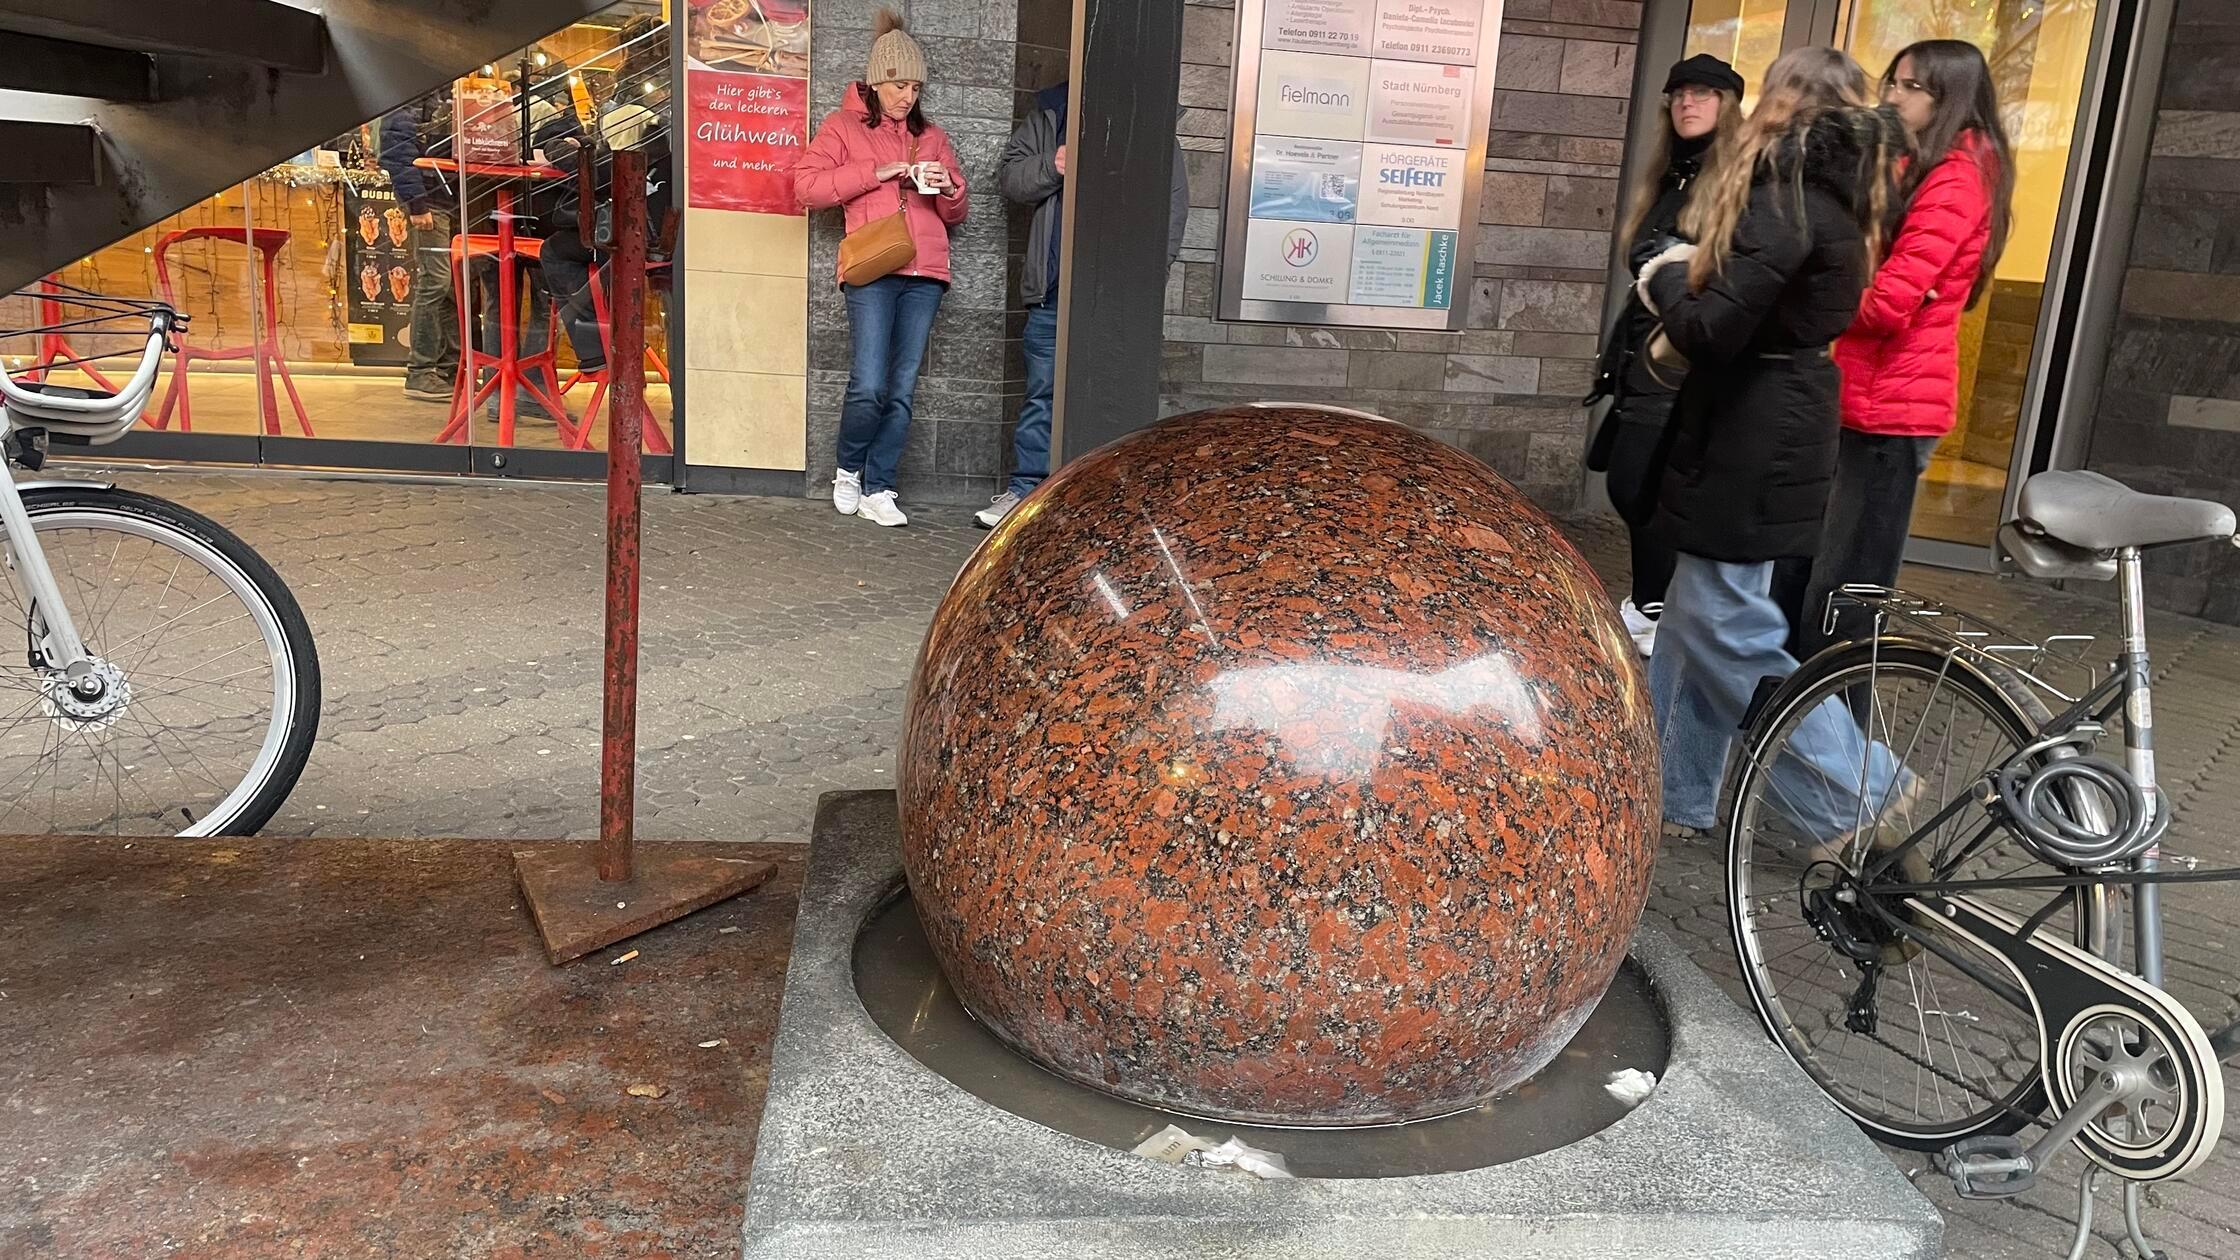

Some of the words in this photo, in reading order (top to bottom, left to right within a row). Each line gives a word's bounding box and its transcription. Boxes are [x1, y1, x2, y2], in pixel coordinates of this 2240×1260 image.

[1279, 27, 1307, 37] Telefon
[1309, 30, 1326, 38] 0911
[1328, 31, 1337, 40] 22
[1381, 40, 1408, 50] Telefon
[1410, 43, 1428, 52] 0911
[717, 84, 744, 96] Hier
[1382, 80, 1410, 91] Stadt
[1413, 82, 1461, 98] Nürnberg
[709, 99, 733, 111] den
[737, 100, 789, 116] leckeren
[697, 121, 799, 146] Glühwein
[713, 158, 737, 169] und
[742, 159, 784, 172] mehr...
[1380, 153, 1448, 167] HÖRGERÄTE
[1380, 167, 1446, 187] SEIFERT
[361, 189, 396, 201] BUBBL
[1372, 230, 1400, 238] Facharzt
[1401, 231, 1411, 239] für
[1436, 234, 1449, 275] Raschke
[1260, 274, 1298, 283] SCHILLING
[1307, 277, 1334, 285] DOMKE
[1433, 277, 1445, 304] Jacek
